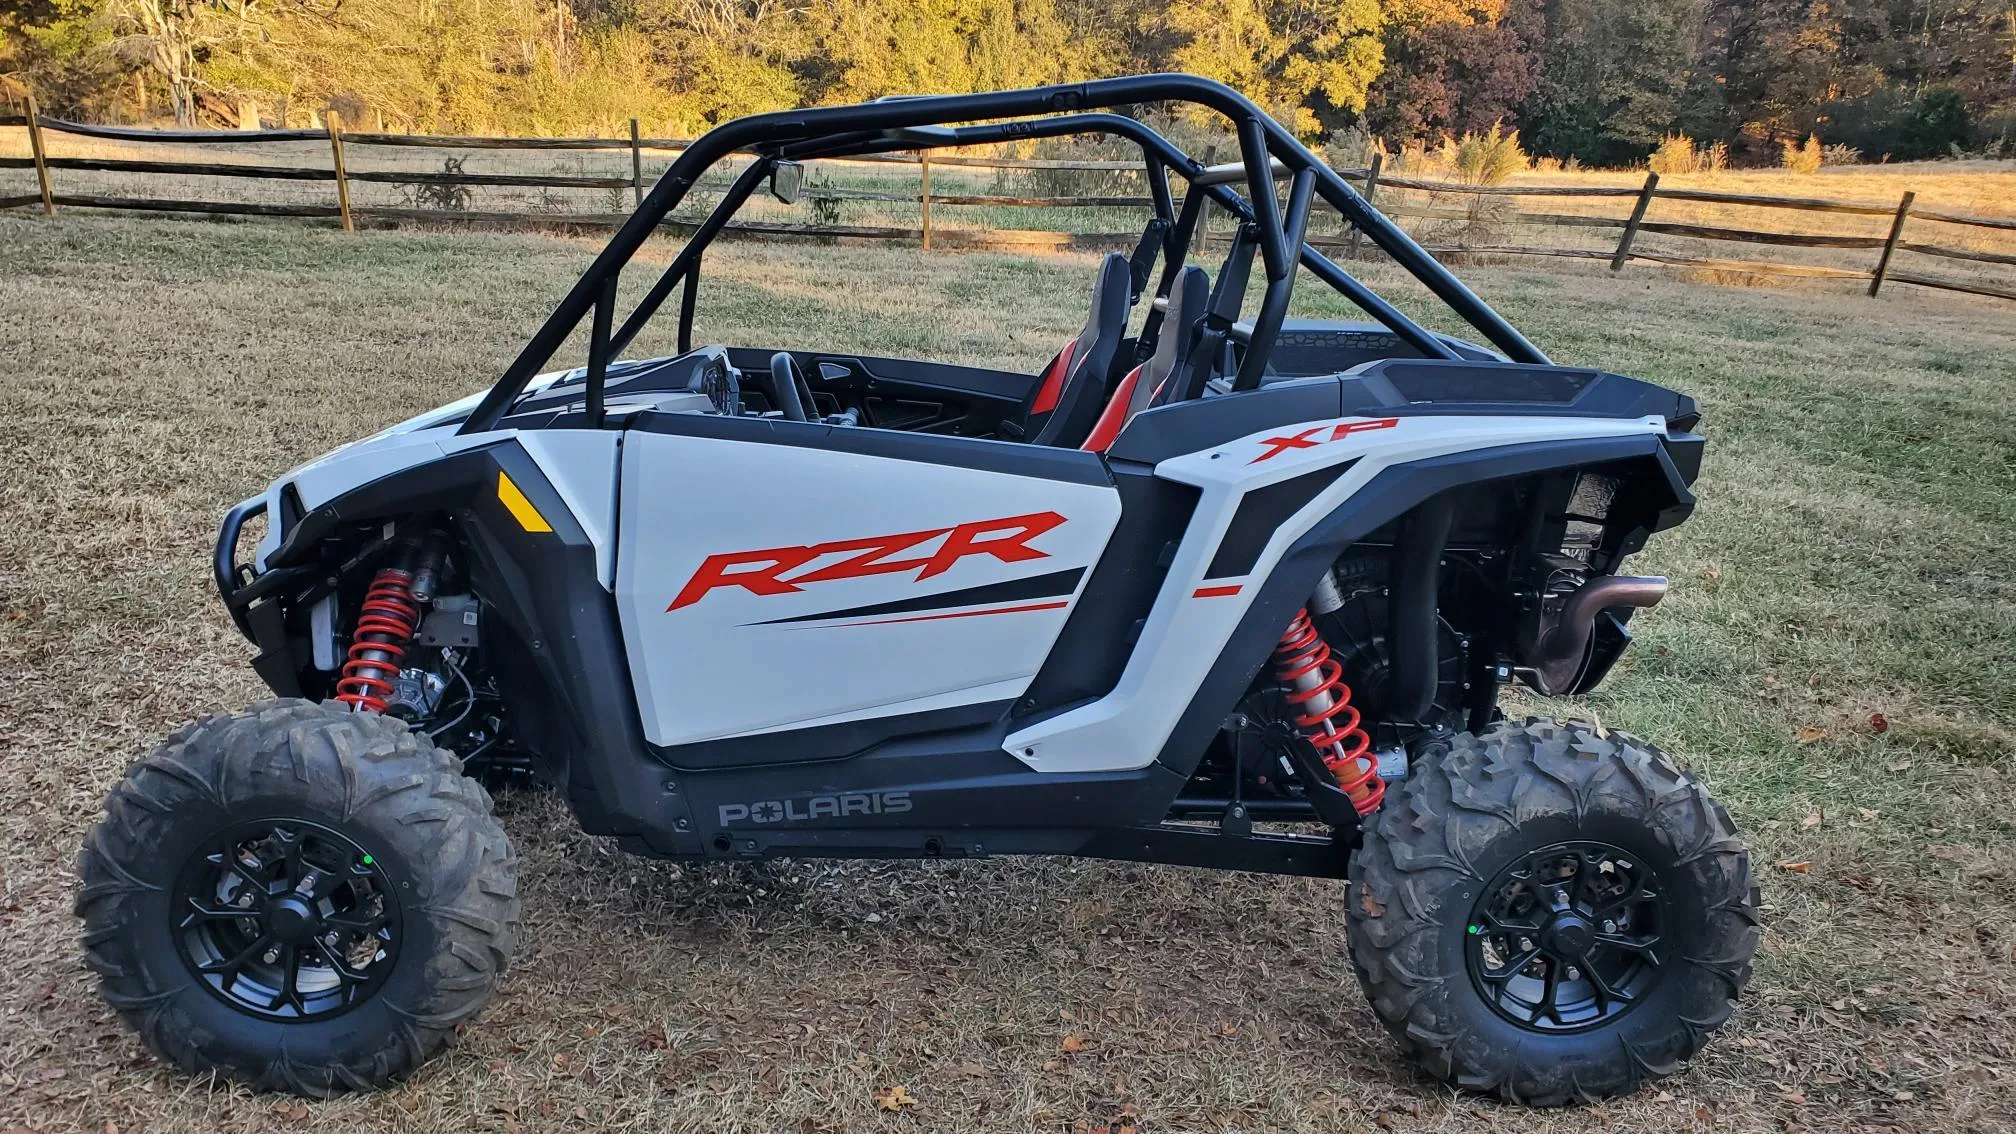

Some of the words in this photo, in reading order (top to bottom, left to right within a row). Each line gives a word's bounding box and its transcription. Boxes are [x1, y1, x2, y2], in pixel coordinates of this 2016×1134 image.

[1245, 418, 1400, 465] XP
[665, 511, 1069, 613] RZR
[718, 792, 913, 827] POLARIS
